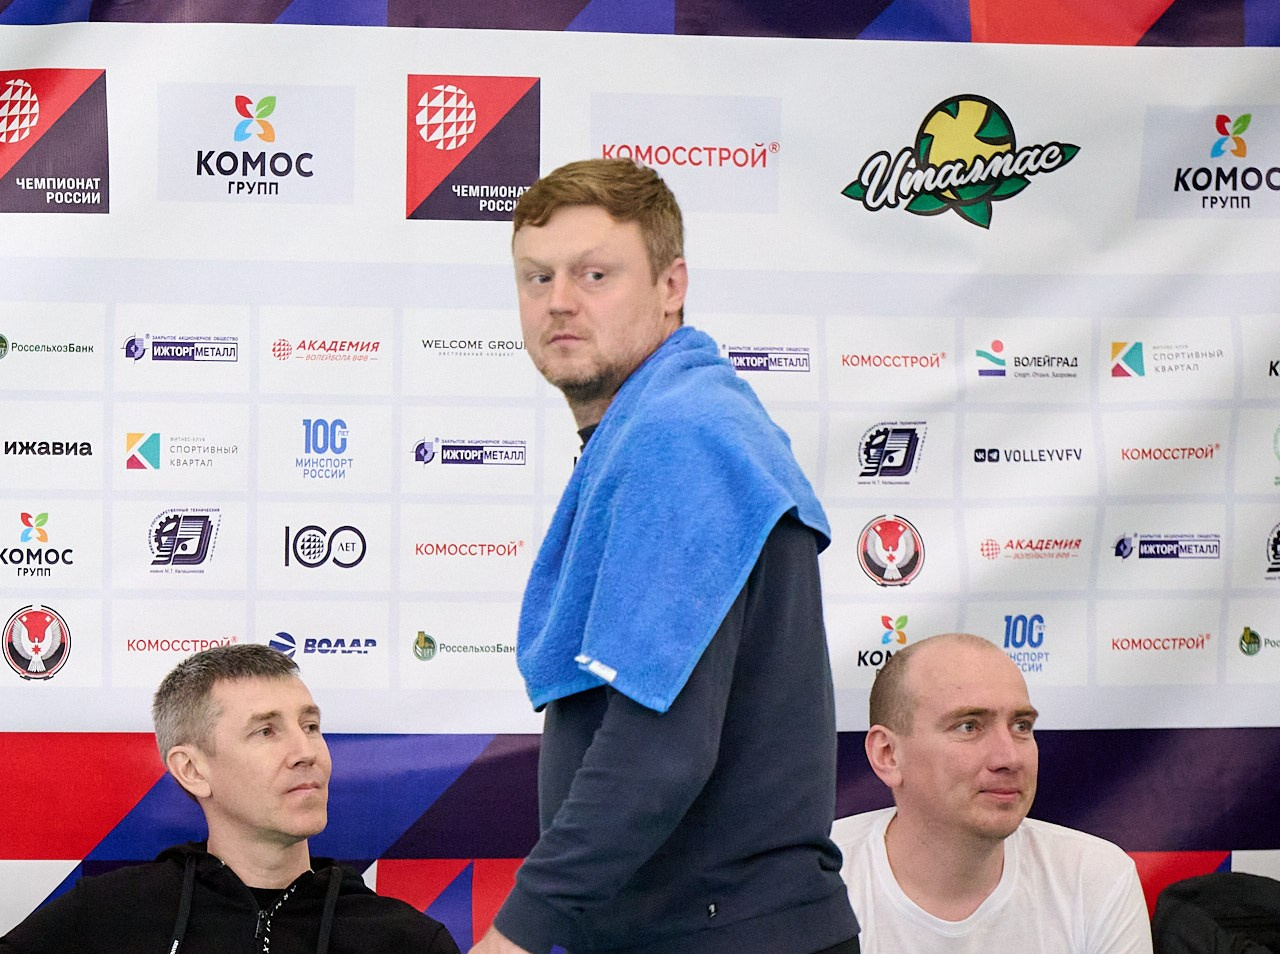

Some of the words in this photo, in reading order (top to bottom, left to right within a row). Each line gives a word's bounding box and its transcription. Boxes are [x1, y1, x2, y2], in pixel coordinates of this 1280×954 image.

[196, 150, 314, 178] КОМОС
[15, 178, 101, 191] ЧЕМПИОНАТ
[227, 182, 279, 195] ГРУПП
[45, 191, 101, 204] РОССИИ
[1201, 196, 1251, 209] ГРУПП
[11, 342, 94, 353] РоссельхозБанк
[296, 340, 380, 353] АКАДЕМИЯ
[422, 339, 483, 350] WELCOME
[153, 346, 236, 357] ИЖТОРГМЕТАЛЛ
[1152, 349, 1224, 361] СПОРТИВНЫЙ
[1014, 355, 1078, 367] ВОЛЕЙГРАД
[1154, 363, 1199, 373] КВАРТАЛ
[302, 418, 348, 455] 100
[169, 444, 238, 454] СПОРТИВНЫЙ
[442, 449, 524, 461] ИЖТОРГМЕТАЛЛ
[1004, 448, 1082, 463] VOLLEYVFV
[170, 458, 213, 467] КВАРТАЛ
[295, 458, 354, 468] МИНСПОРТ
[303, 469, 346, 479] РОССИИ
[1004, 538, 1081, 551] АКАДЕМИЯ
[1140, 544, 1218, 554] ИЖТОРГМЕТАЛЛ
[17, 567, 51, 577] ГРУПП
[1004, 614, 1044, 648] 100
[439, 643, 517, 653] РоссельхозБан
